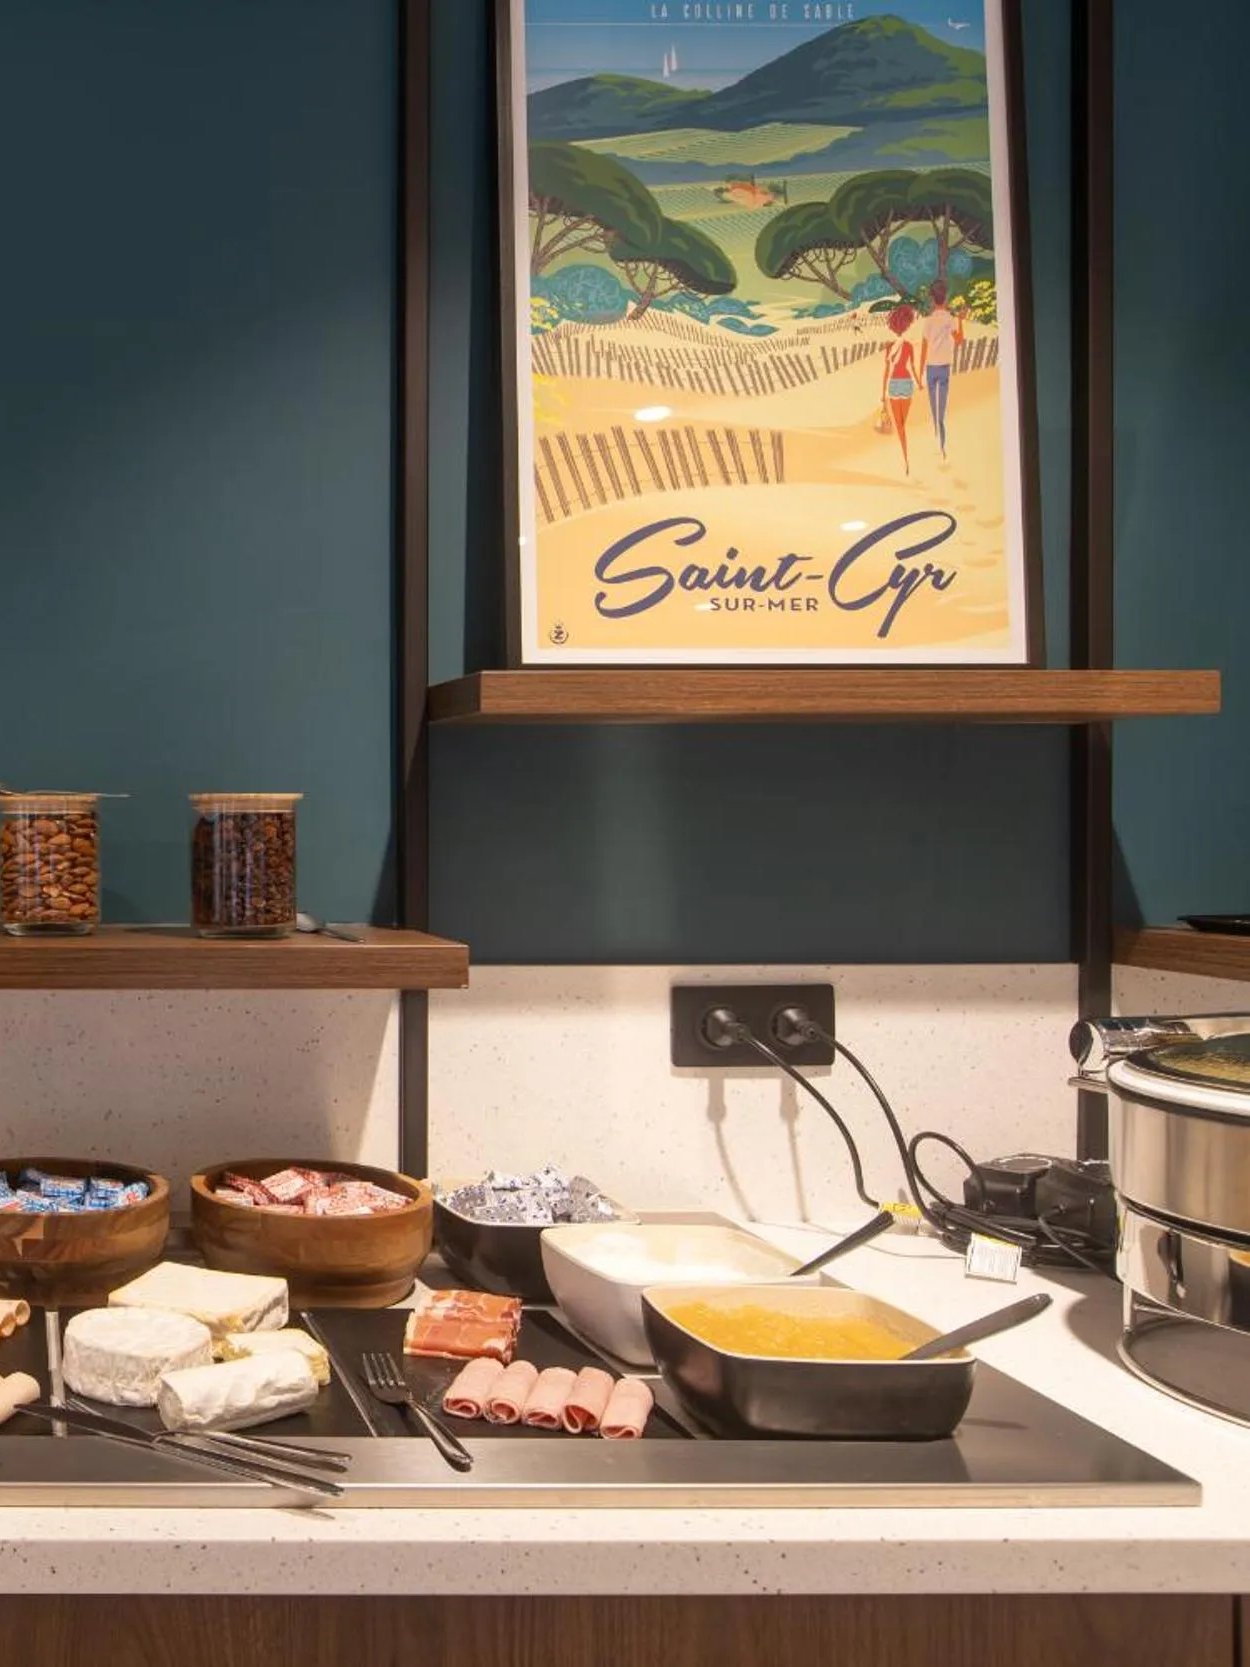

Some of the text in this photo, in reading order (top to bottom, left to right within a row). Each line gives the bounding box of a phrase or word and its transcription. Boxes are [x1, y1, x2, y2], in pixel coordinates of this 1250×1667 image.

[650, 3, 668, 19] LA
[683, 3, 755, 19] COLLINE
[769, 3, 789, 19] DE
[594, 510, 958, 639] Saint-Cyr
[709, 597, 819, 612] SUR-MER
